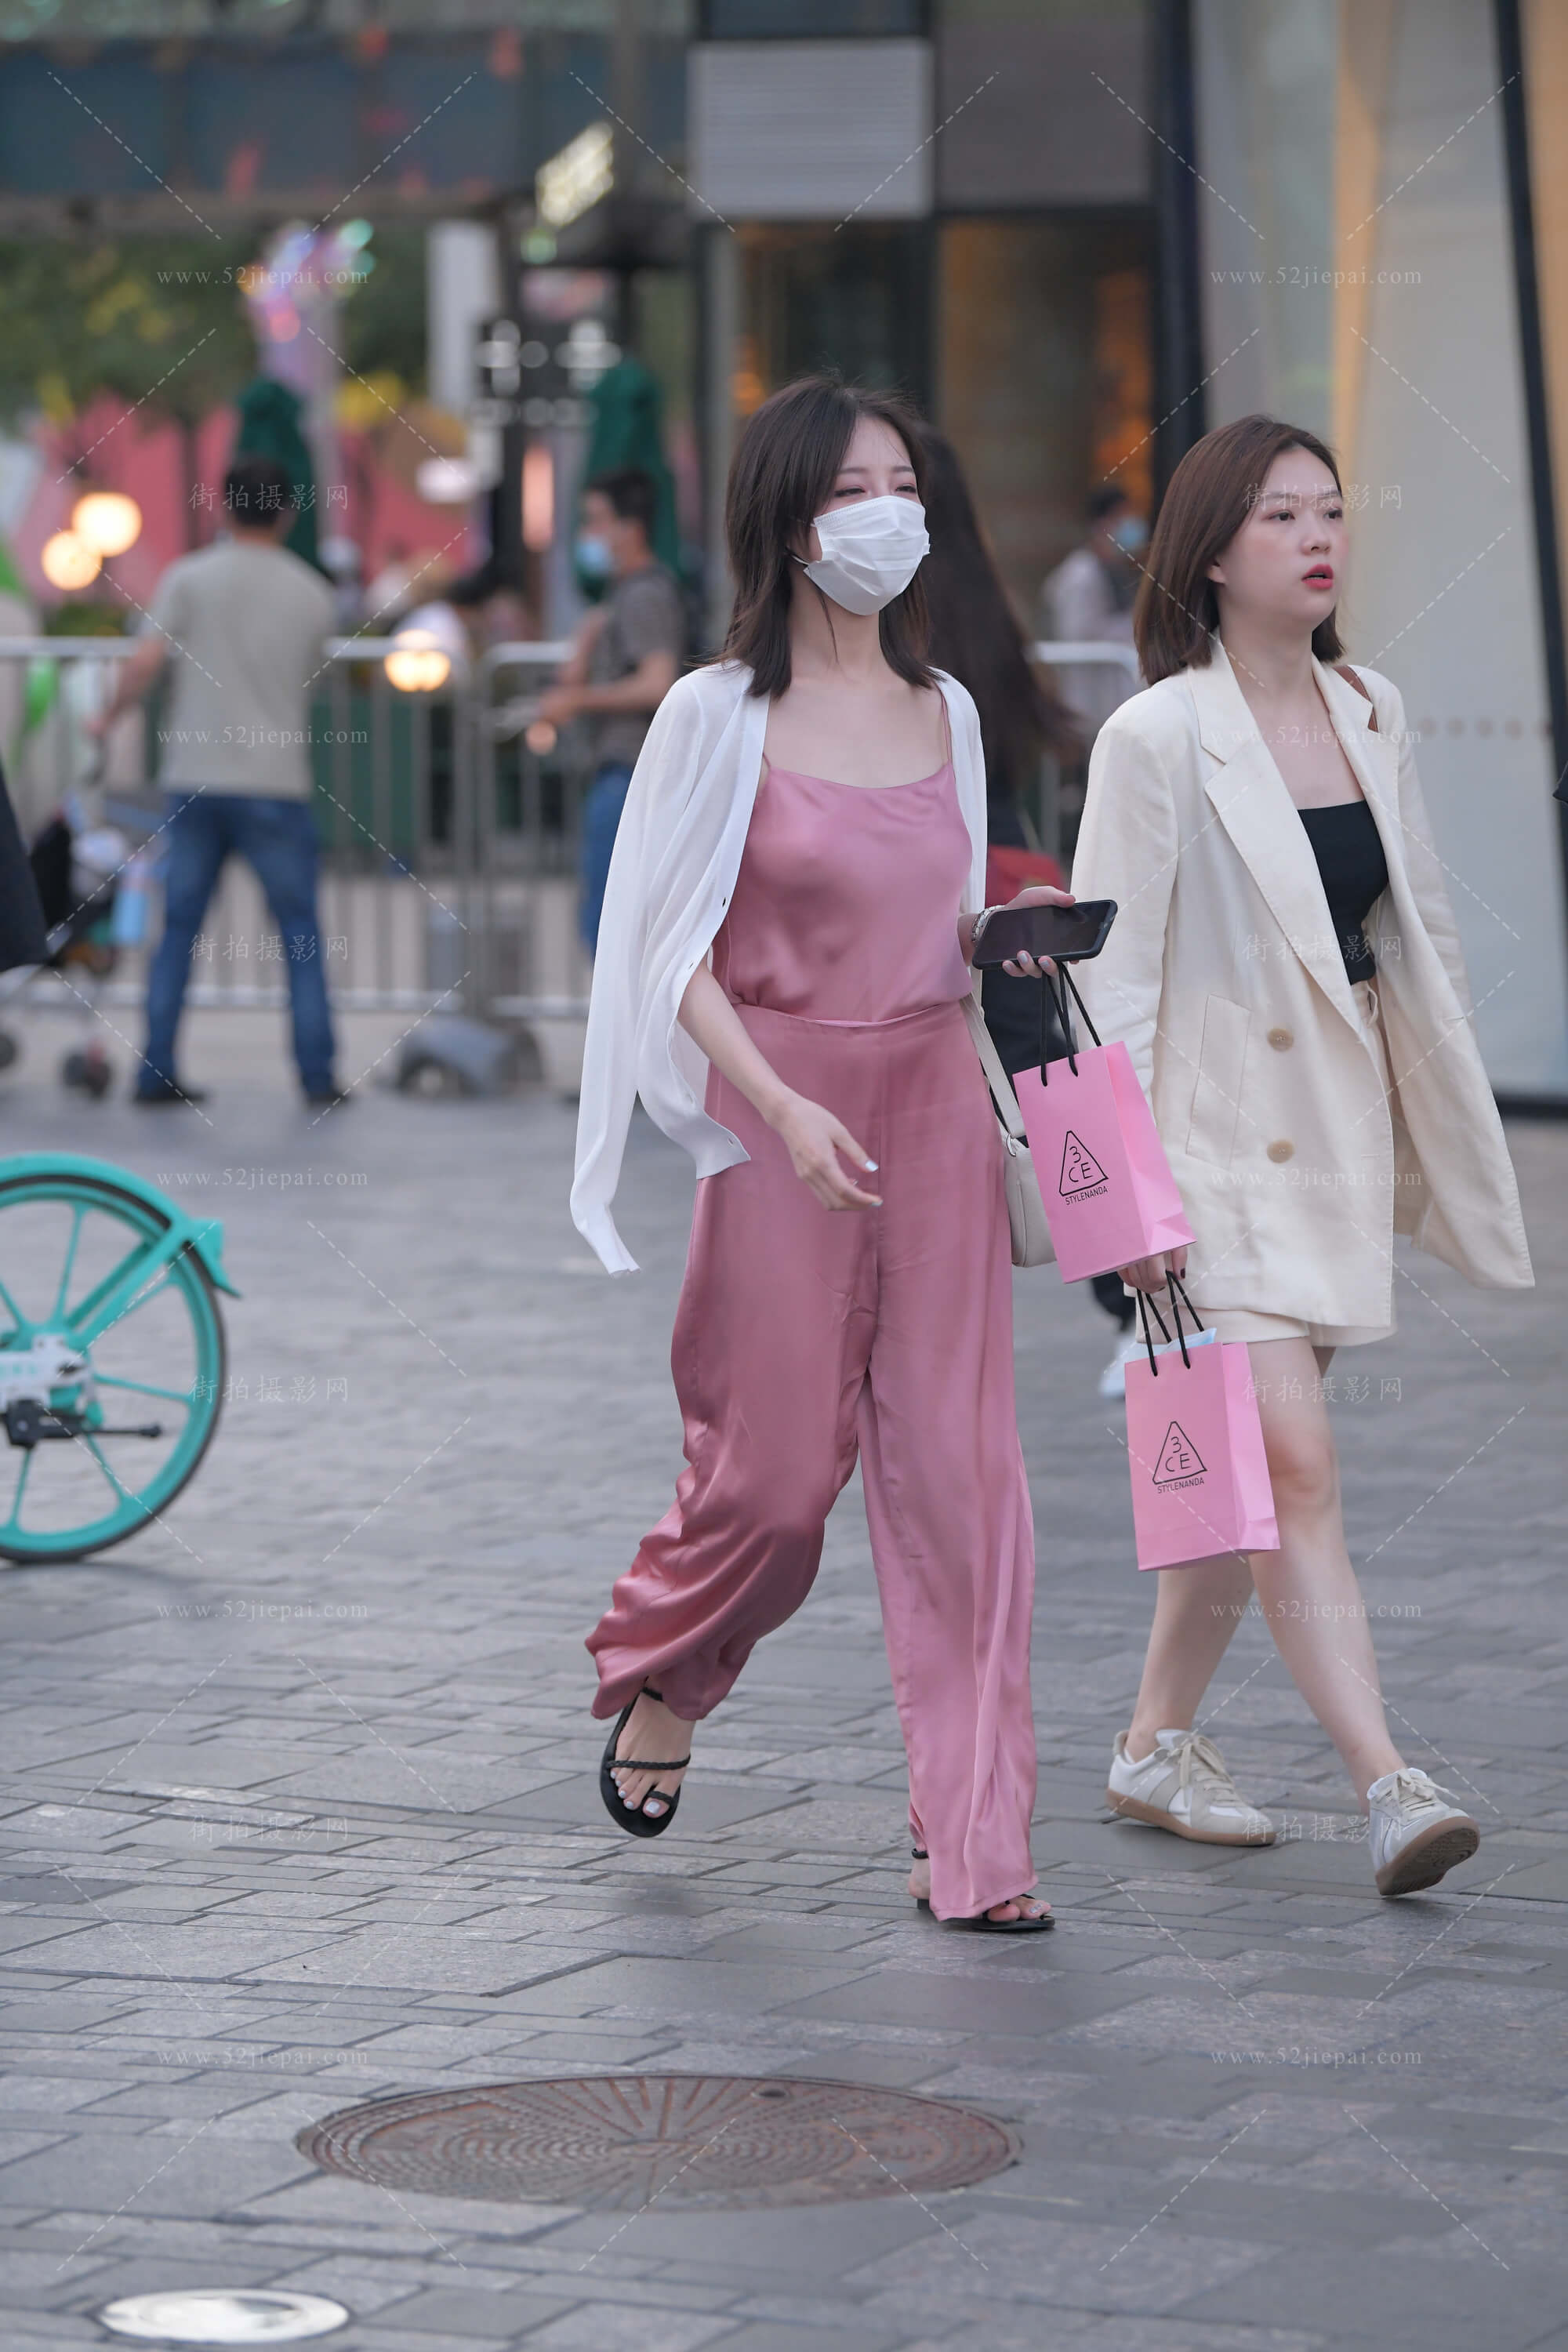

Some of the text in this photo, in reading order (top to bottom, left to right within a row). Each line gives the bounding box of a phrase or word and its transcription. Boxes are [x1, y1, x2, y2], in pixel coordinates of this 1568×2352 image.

[1069, 1146, 1081, 1163] 3
[1069, 1162, 1094, 1183] CE
[1065, 1185, 1109, 1206] STYLENANDA
[1171, 1436, 1182, 1454] 3
[1165, 1453, 1192, 1472] CE
[1157, 1477, 1205, 1494] STYLENANDA
